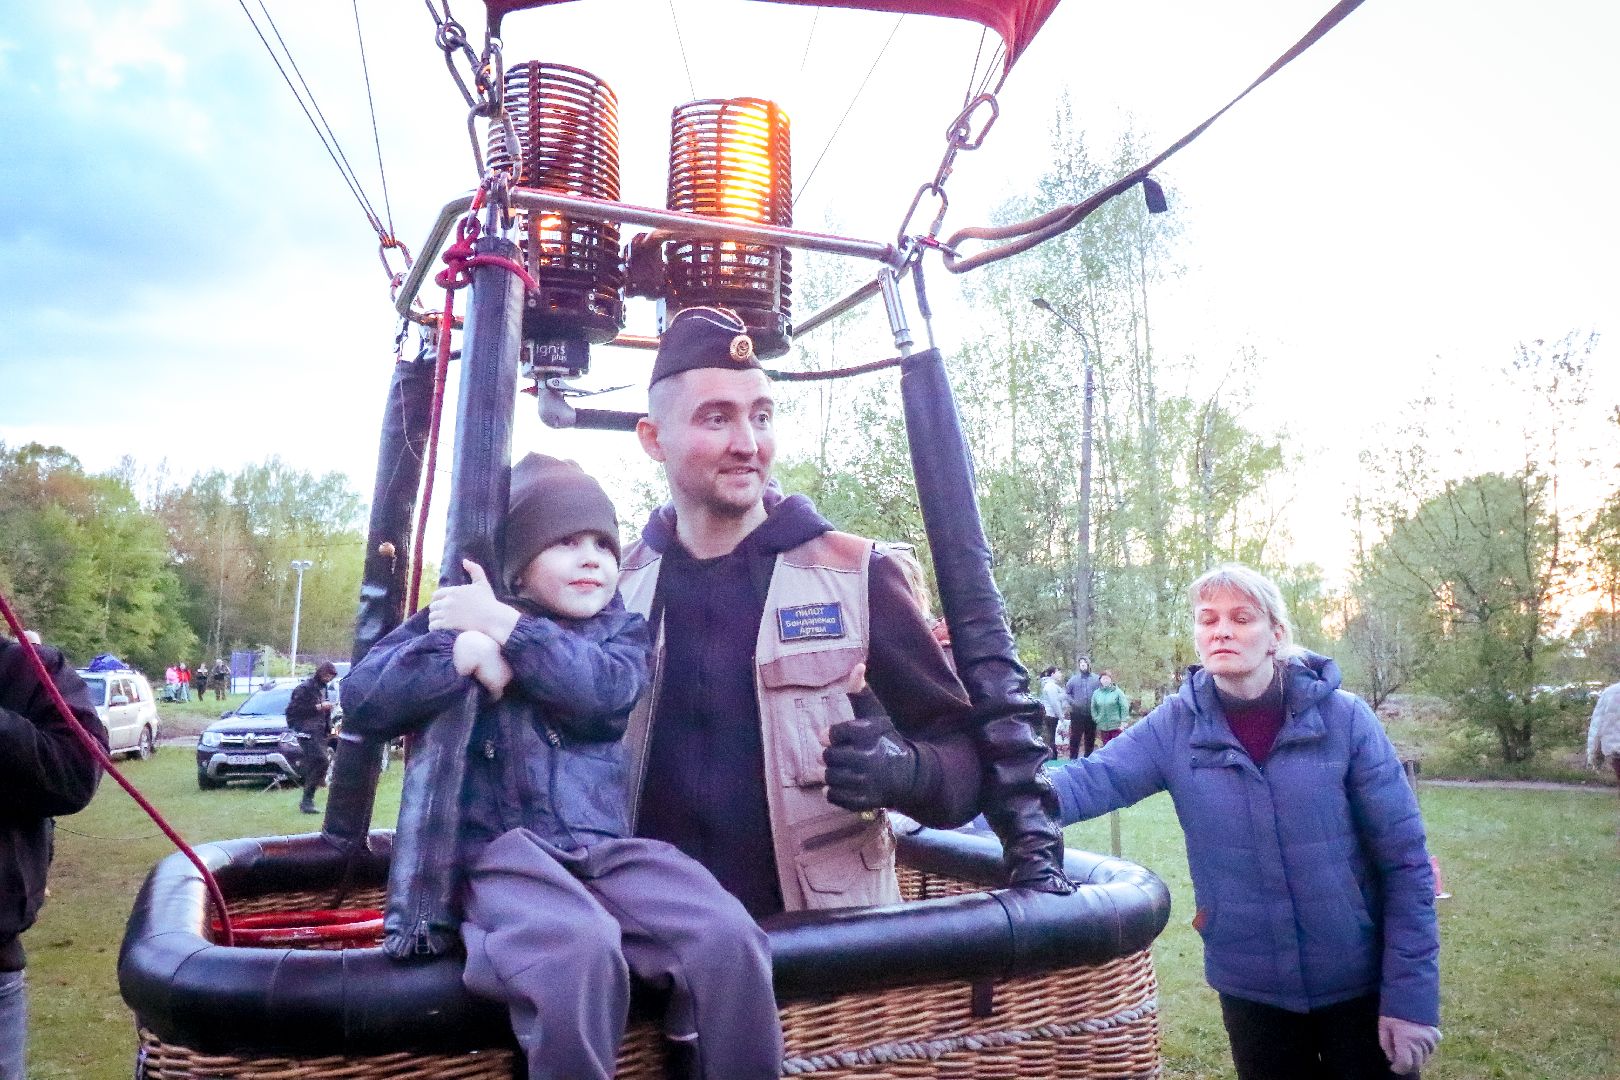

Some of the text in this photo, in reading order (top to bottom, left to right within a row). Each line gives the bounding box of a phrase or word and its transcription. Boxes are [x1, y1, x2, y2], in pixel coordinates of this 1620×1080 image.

[551, 353, 567, 362] plus
[795, 607, 824, 617] ПИЛОТ
[785, 617, 836, 627] Бондаренко
